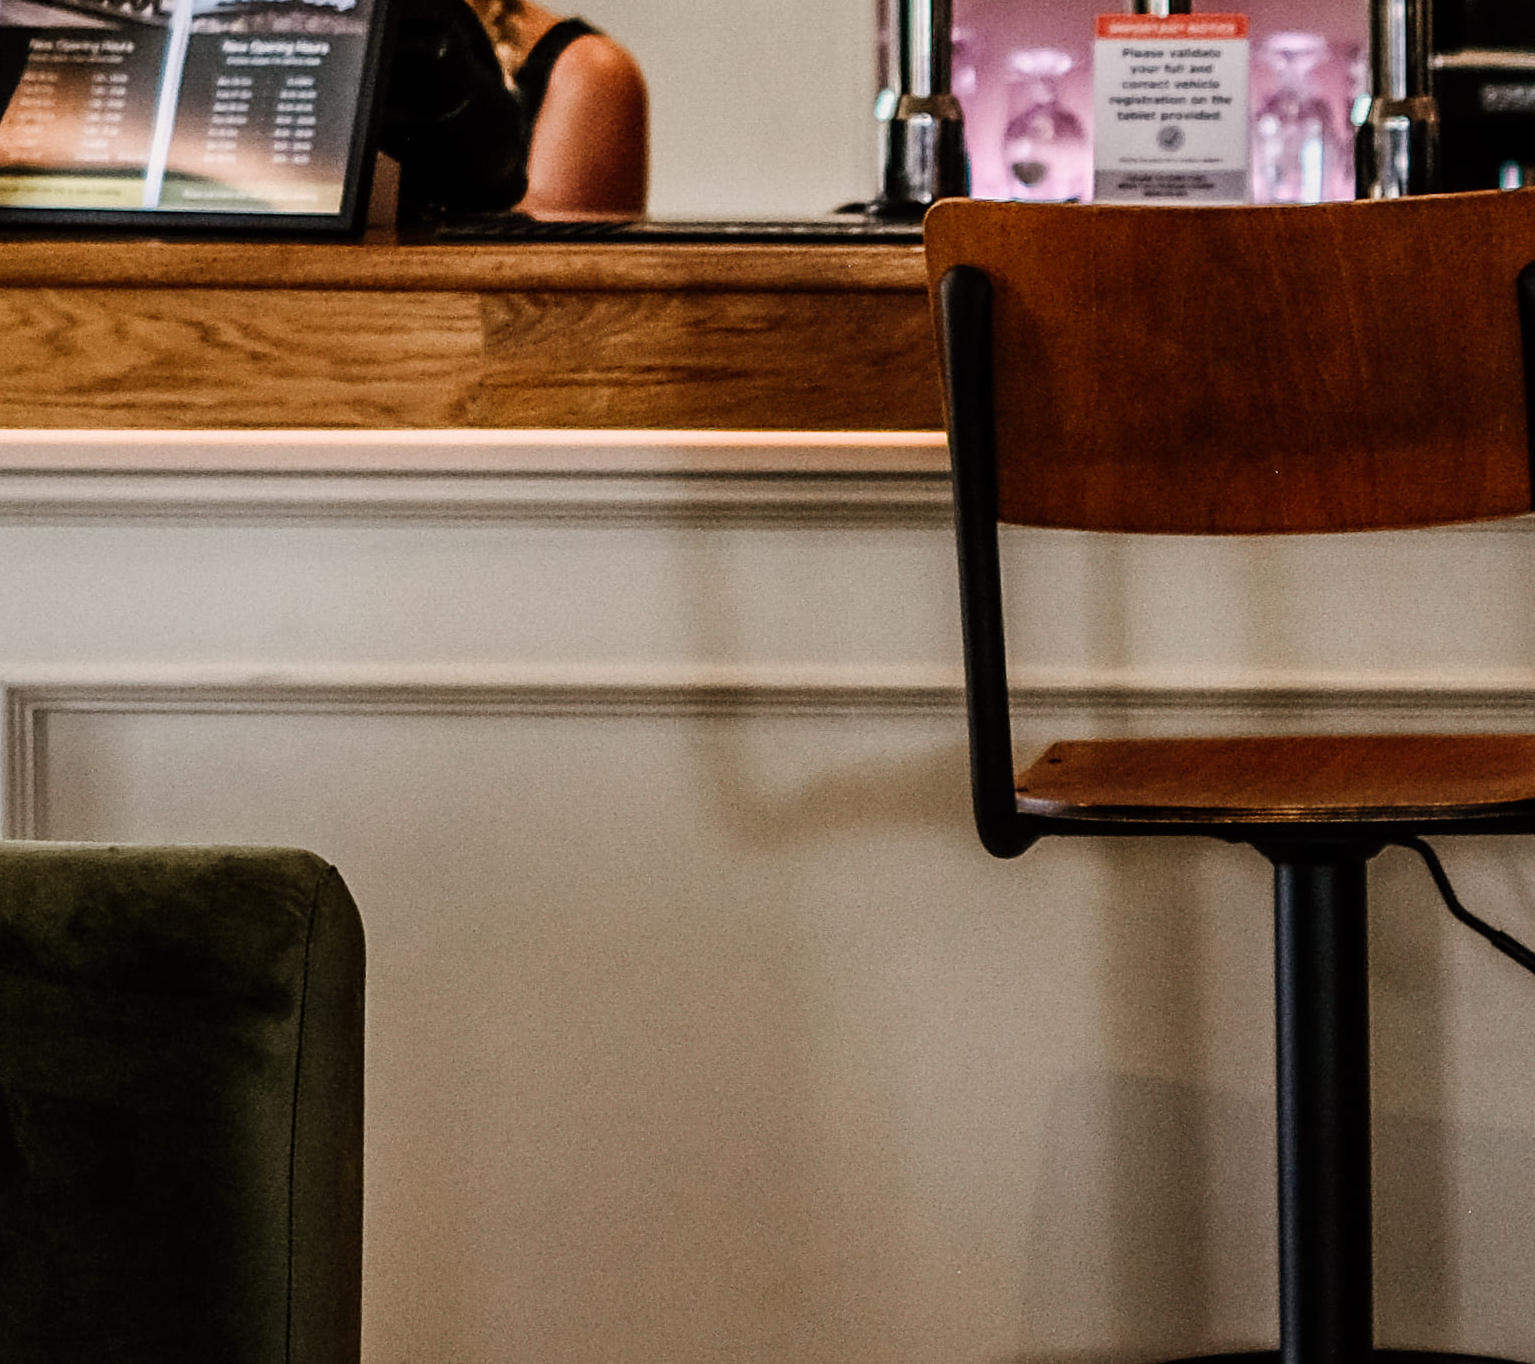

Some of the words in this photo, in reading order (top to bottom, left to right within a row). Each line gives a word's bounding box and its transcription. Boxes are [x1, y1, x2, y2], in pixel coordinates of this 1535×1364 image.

[1122, 48, 1164, 58] Please
[1170, 48, 1221, 58] validate
[1130, 66, 1160, 75] your
[1164, 64, 1184, 73] full
[1190, 65, 1213, 73] and
[1122, 80, 1170, 89] correct
[1174, 80, 1220, 89] vehicle
[1108, 96, 1186, 107] registration
[1191, 97, 1207, 105] on
[1212, 96, 1232, 105] the
[1117, 112, 1156, 120] tablet
